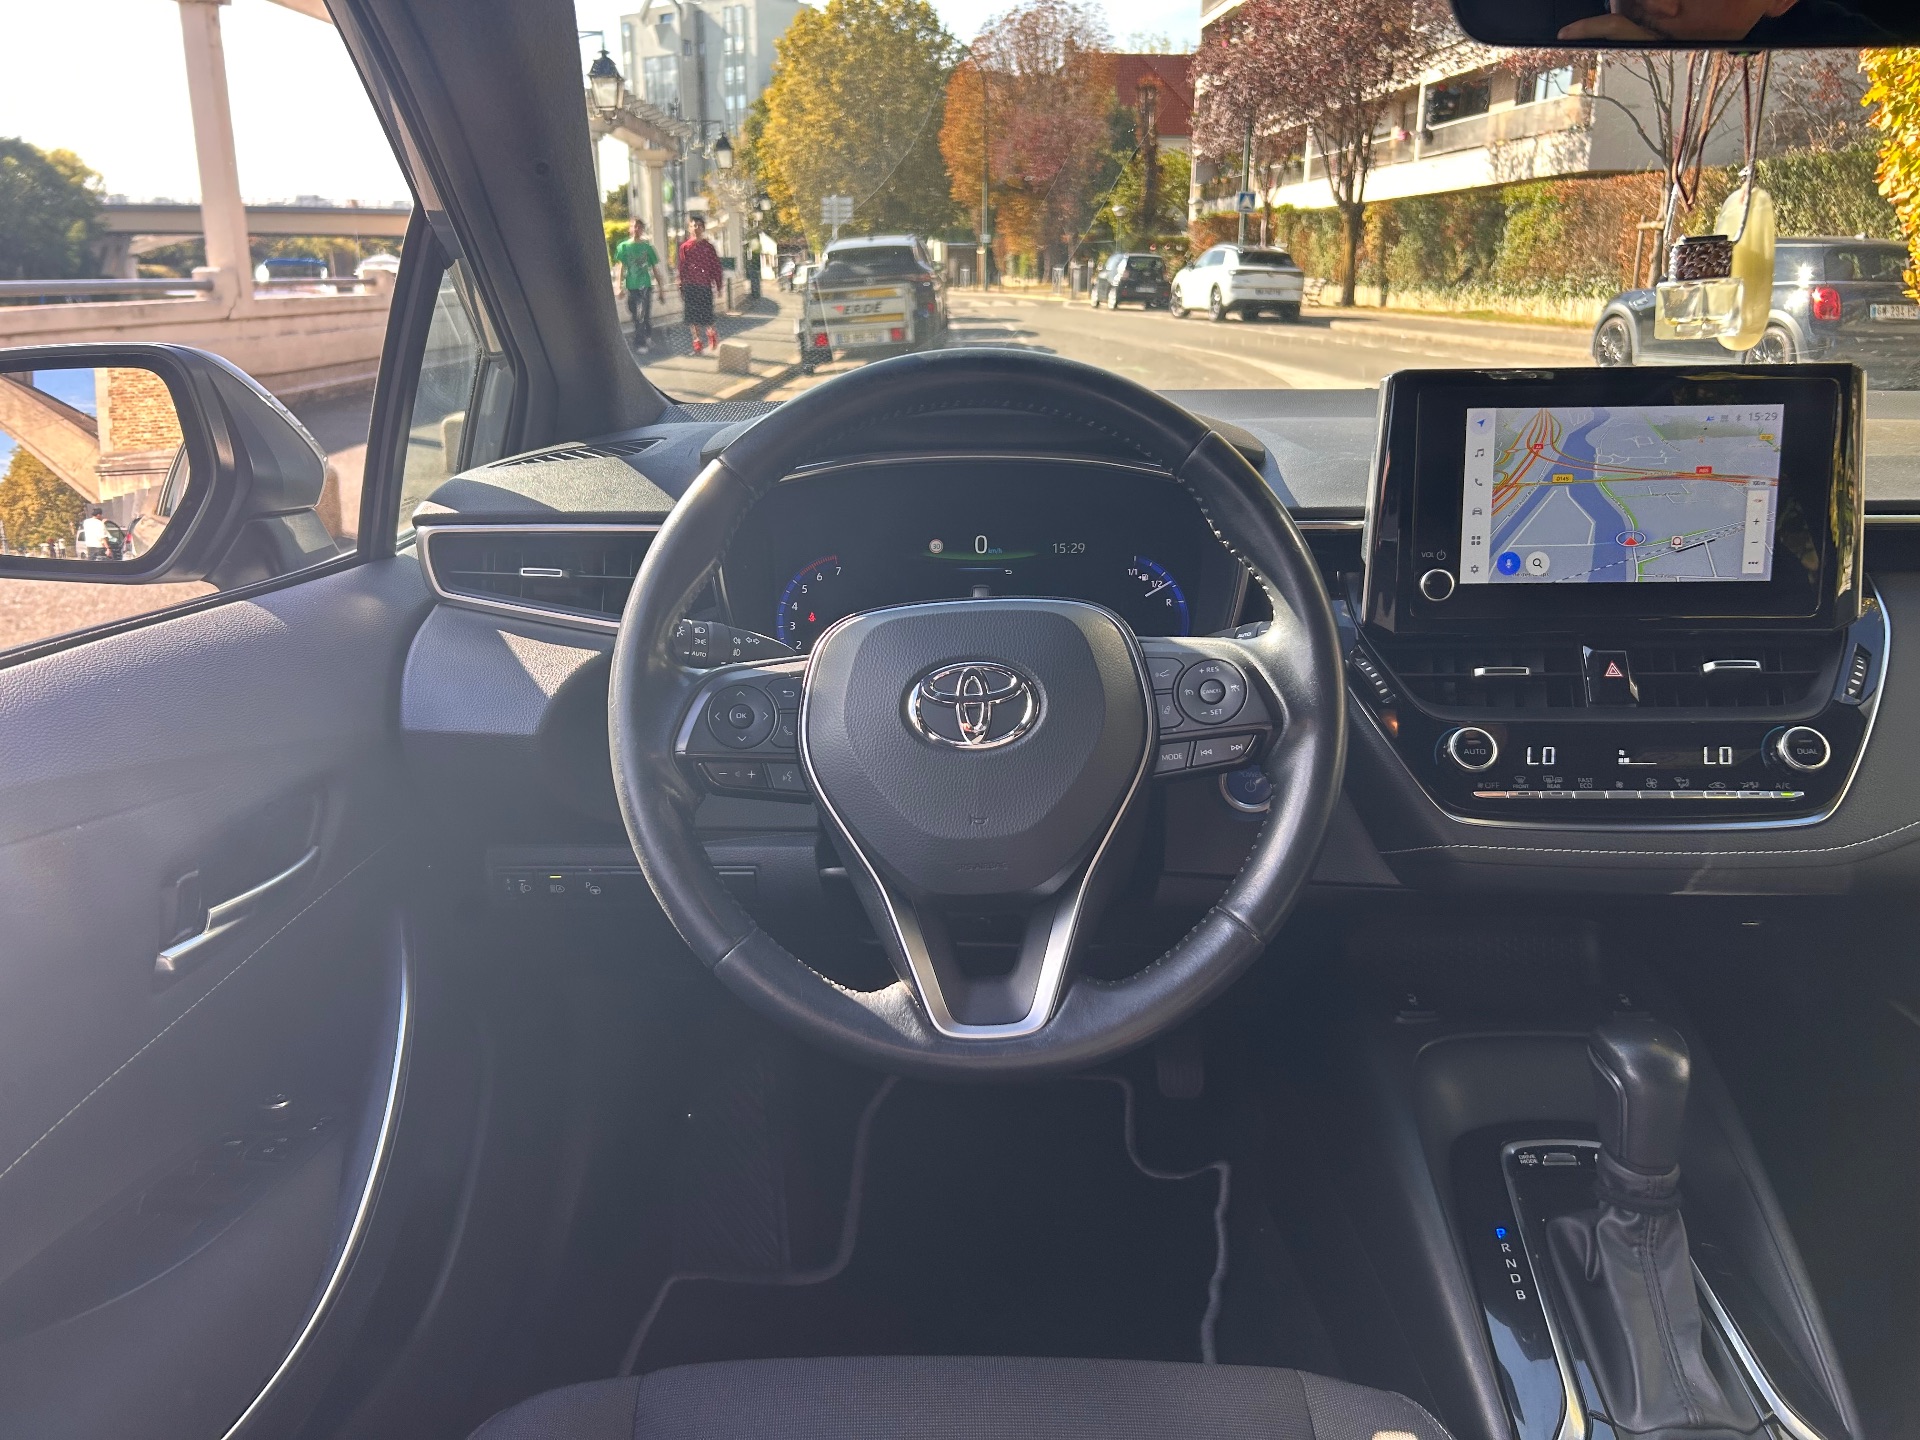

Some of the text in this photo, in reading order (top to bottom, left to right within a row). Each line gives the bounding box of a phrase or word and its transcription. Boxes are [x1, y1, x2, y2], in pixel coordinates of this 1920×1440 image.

[1748, 411, 1778, 421] 15:29
[974, 534, 1003, 555] 0 km/h
[1052, 542, 1086, 554] 15:29
[835, 566, 842, 576] 7
[1127, 567, 1138, 576] 1/1
[816, 572, 823, 581] 6
[801, 584, 808, 594] 5
[1151, 579, 1163, 589] 1/2
[791, 601, 798, 611] 4
[1166, 598, 1172, 607] R
[789, 621, 796, 631] 3
[795, 640, 802, 650] 2
[1206, 665, 1219, 673] RES
[1209, 708, 1223, 716] SET
[1161, 752, 1183, 761] MODE
[1775, 781, 1791, 789] A/C
[1496, 1228, 1506, 1239] P
[1501, 1243, 1512, 1253] R
[1505, 1258, 1517, 1269] N
[1510, 1273, 1521, 1283] D
[1515, 1289, 1526, 1300] B
